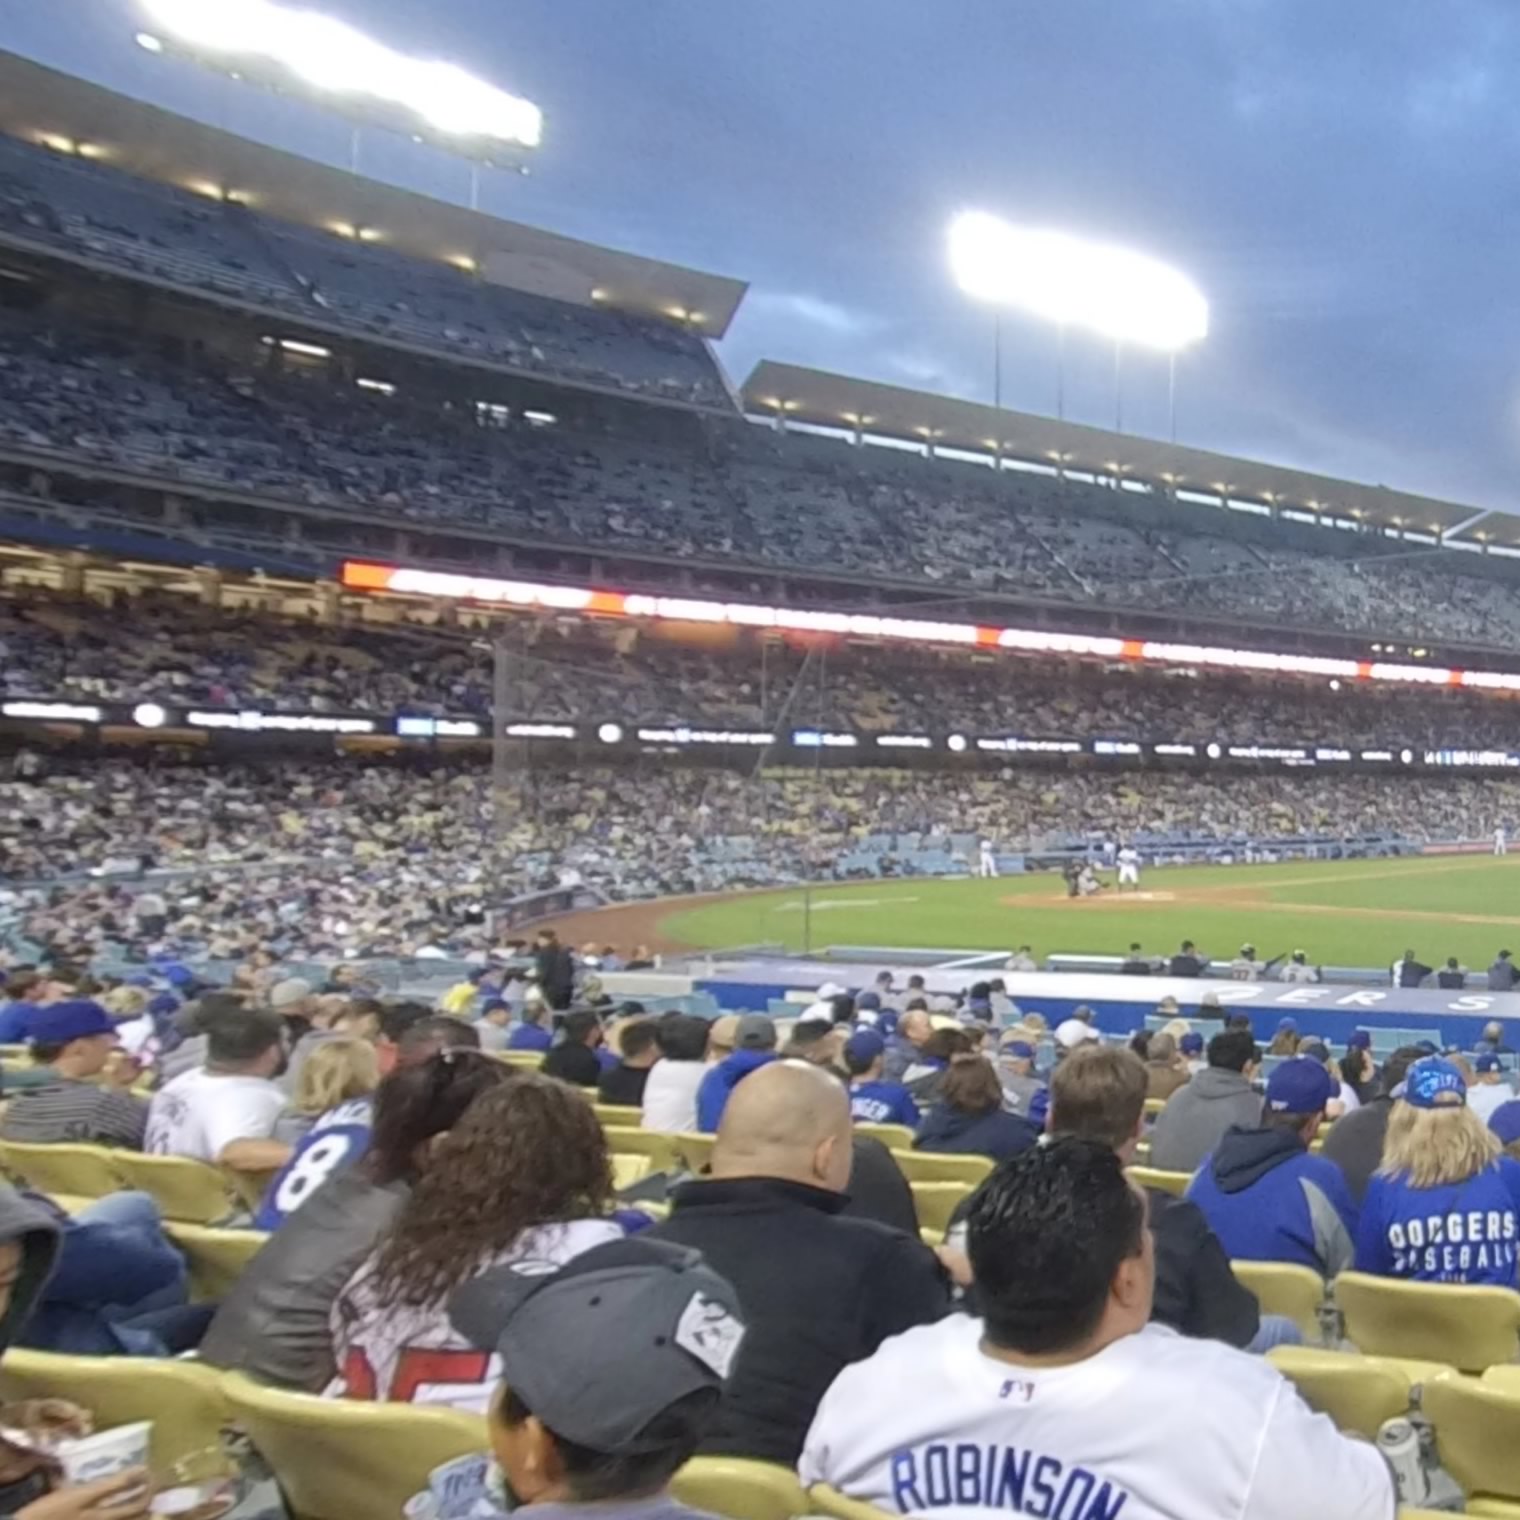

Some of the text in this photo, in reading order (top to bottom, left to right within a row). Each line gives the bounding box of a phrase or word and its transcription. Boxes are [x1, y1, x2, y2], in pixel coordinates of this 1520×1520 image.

[276, 1133, 350, 1212] 8
[1388, 1210, 1515, 1249] DODGERS
[891, 1444, 1127, 1520] ROBINSON
